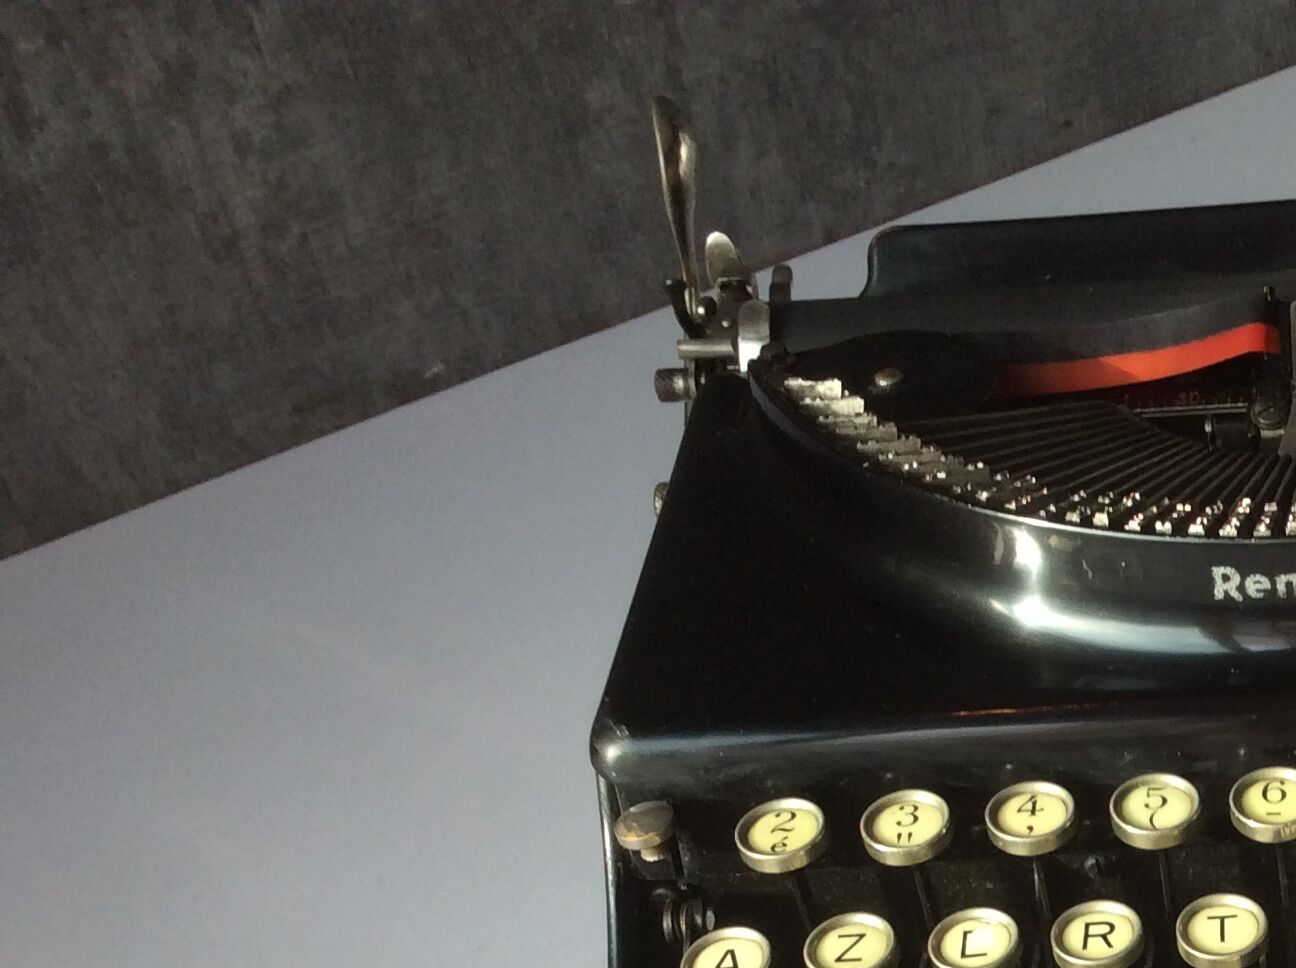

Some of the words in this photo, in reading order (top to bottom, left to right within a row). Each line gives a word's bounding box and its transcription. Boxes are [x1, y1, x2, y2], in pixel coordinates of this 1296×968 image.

[1144, 787, 1168, 809] 5
[1261, 780, 1287, 804] 6
[896, 804, 919, 827] 3
[1016, 796, 1045, 817] 4
[771, 811, 797, 833] 2
[1082, 921, 1116, 950] R
[1207, 914, 1238, 942] T
[834, 933, 867, 963] Z
